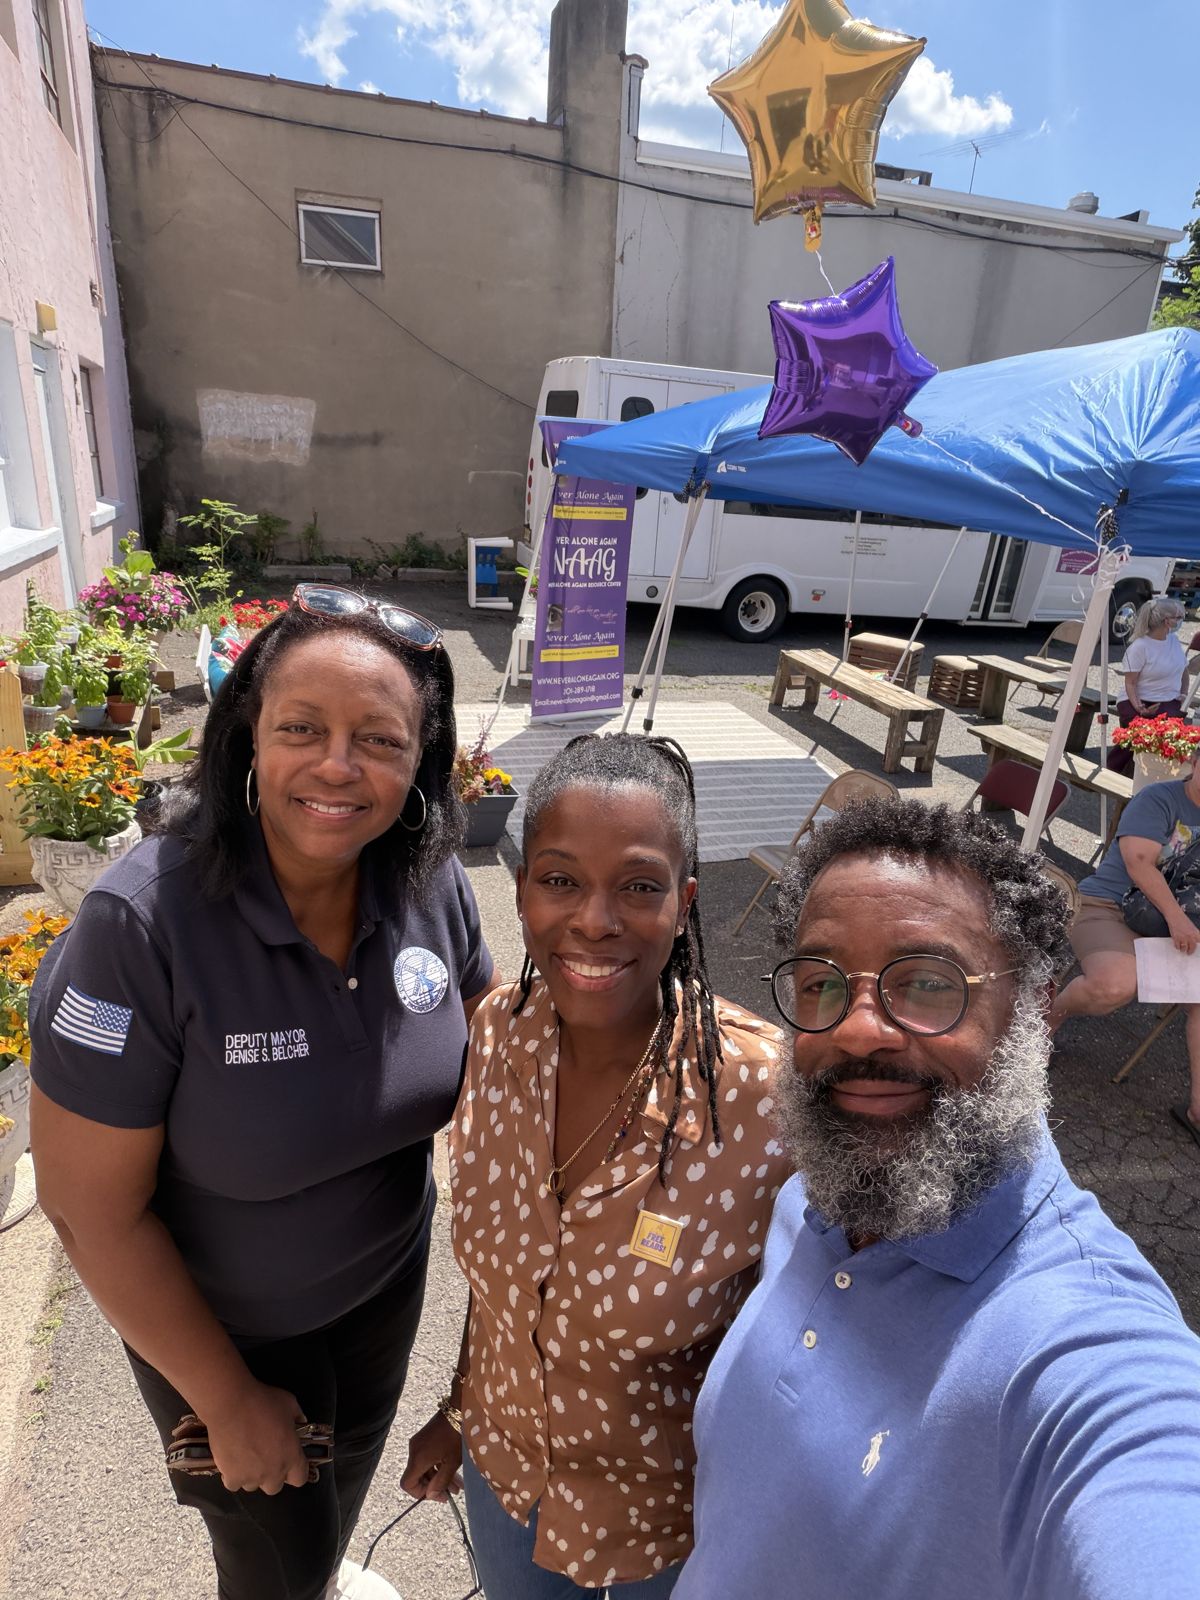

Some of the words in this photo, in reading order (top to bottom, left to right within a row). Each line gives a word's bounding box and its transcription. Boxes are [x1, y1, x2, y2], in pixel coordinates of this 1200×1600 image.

[576, 489, 600, 500] Alone
[602, 491, 624, 503] Again
[571, 536, 598, 545] ALONE
[599, 537, 618, 546] AGAIN
[554, 547, 616, 582] NAAG
[571, 631, 592, 642] Alone
[593, 631, 615, 643] Again
[537, 672, 620, 685] WWW.NEVERALONEAGAIN.ORG
[225, 1032, 268, 1049] DEPUTY
[270, 1028, 307, 1046] MAYOR
[225, 1048, 260, 1065] DENISE
[261, 1047, 271, 1062] S.
[271, 1042, 310, 1062] BELCHER
[647, 1232, 665, 1245] FREE
